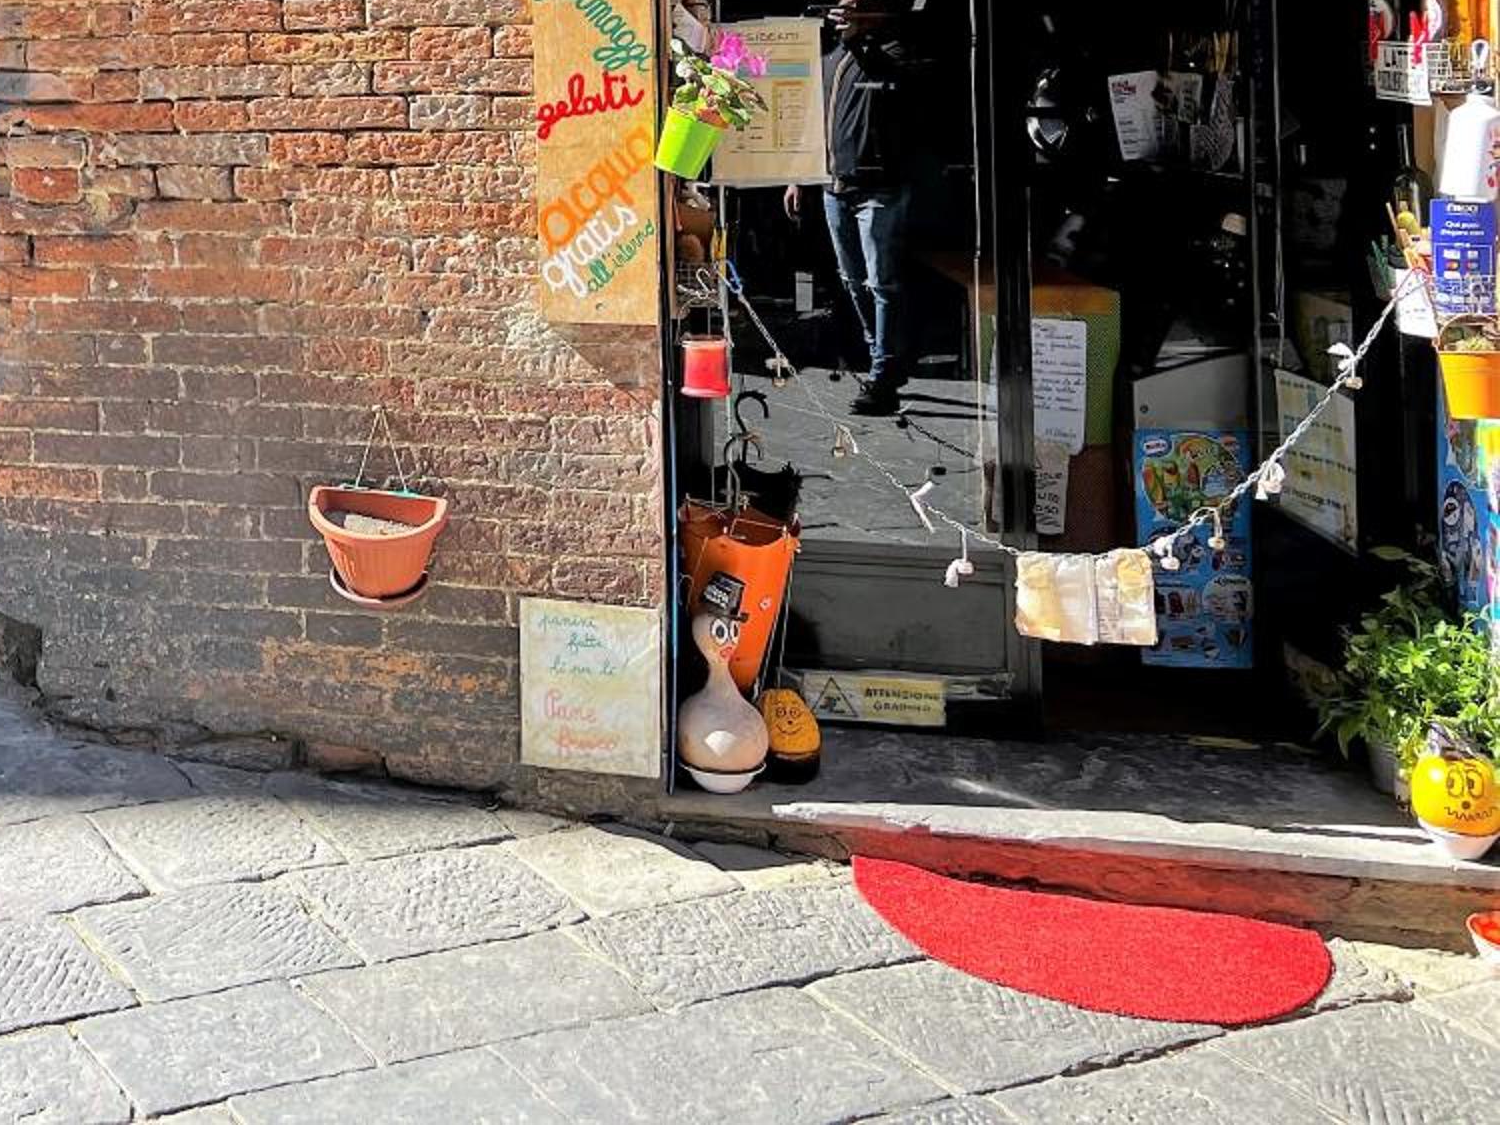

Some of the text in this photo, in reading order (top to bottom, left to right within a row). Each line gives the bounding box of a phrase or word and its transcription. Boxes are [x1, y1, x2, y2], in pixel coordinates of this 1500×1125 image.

[535, 70, 646, 142] gelati
[542, 203, 639, 300] gratis
[863, 686, 943, 704] ATTENZIONE
